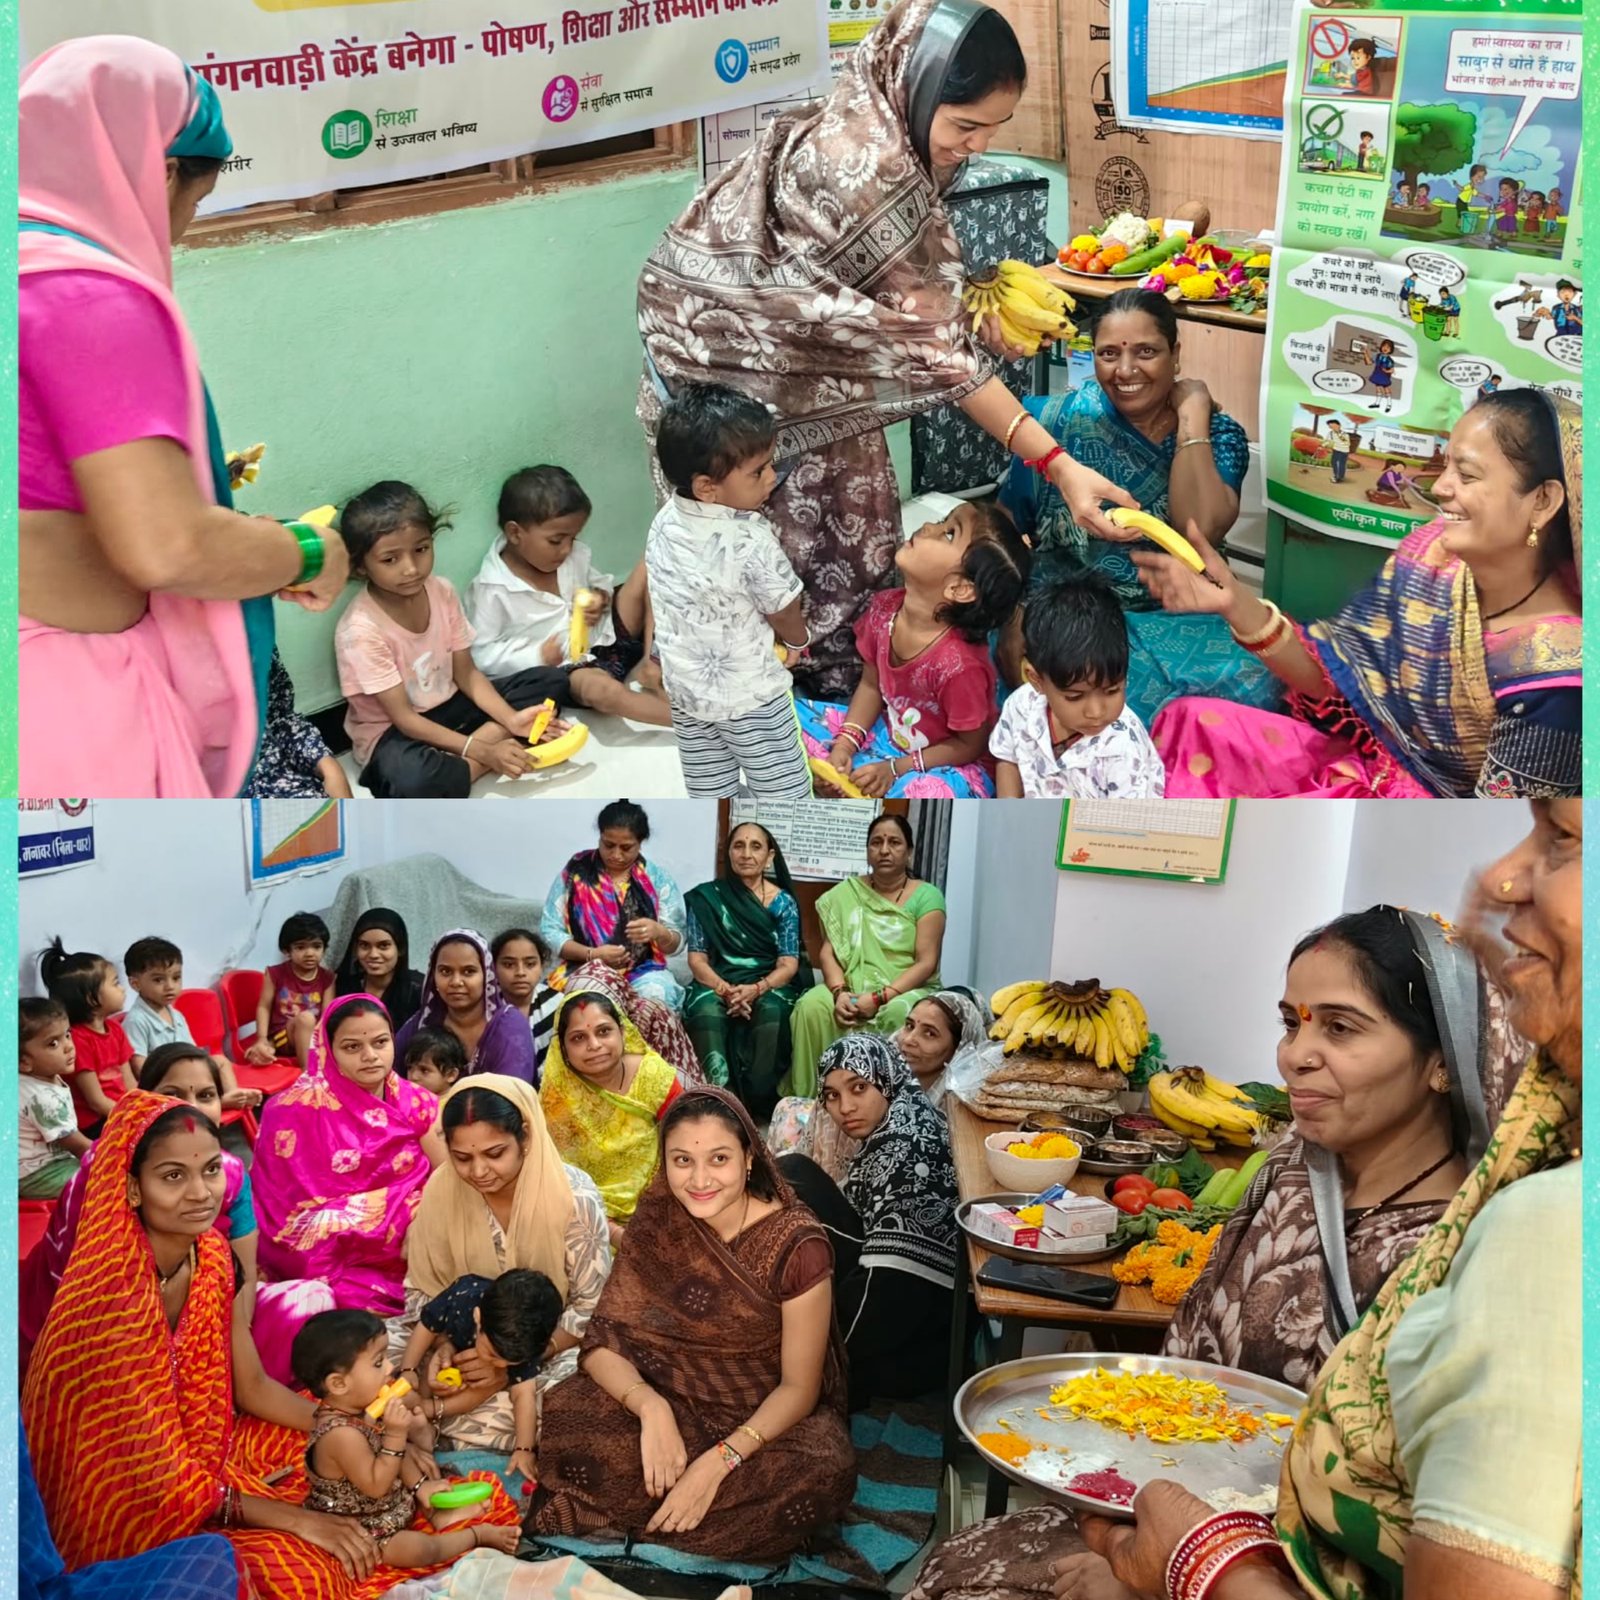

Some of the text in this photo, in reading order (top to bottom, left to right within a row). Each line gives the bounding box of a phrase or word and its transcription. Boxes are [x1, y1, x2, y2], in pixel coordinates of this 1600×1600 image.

[330, 36, 378, 77] केंद्र
[385, 31, 456, 70] बनेगा
[481, 20, 554, 57] पोषण,
[562, 9, 614, 45] शिक्षा
[618, 0, 650, 33] और
[747, 36, 780, 55] सम्मान
[1527, 40, 1541, 50] का
[749, 51, 801, 75] से समृद्ध प्रदेश
[1457, 55, 1489, 72] साबुन
[1491, 54, 1504, 69] से
[1551, 60, 1576, 74] हाथ
[579, 72, 603, 91] सेवा
[1546, 79, 1555, 89] के
[1558, 82, 1575, 92] बाद
[580, 86, 653, 112] से सुरक्षित समाज
[375, 108, 418, 128] शिक्षा
[375, 122, 478, 150] से उज्जवल भविष्य
[722, 128, 751, 141] सोमवार
[1114, 185, 1131, 196] ISO
[1304, 182, 1374, 200] कचरा पेटी का
[1297, 201, 1329, 214] उपयोग
[1356, 208, 1376, 220] नगर
[1297, 219, 1311, 233] को
[1314, 223, 1343, 237] स्वच्छ
[1323, 257, 1342, 267] कचरे
[1344, 257, 1355, 268] को
[1330, 270, 1352, 281] प्रयोग
[1316, 280, 1327, 290] की
[1330, 283, 1348, 293] मात्रा
[1361, 286, 1379, 297] कमी
[1331, 507, 1377, 528] एकीकृत
[1380, 518, 1406, 532] बाल
[22, 844, 52, 862] मनावर
